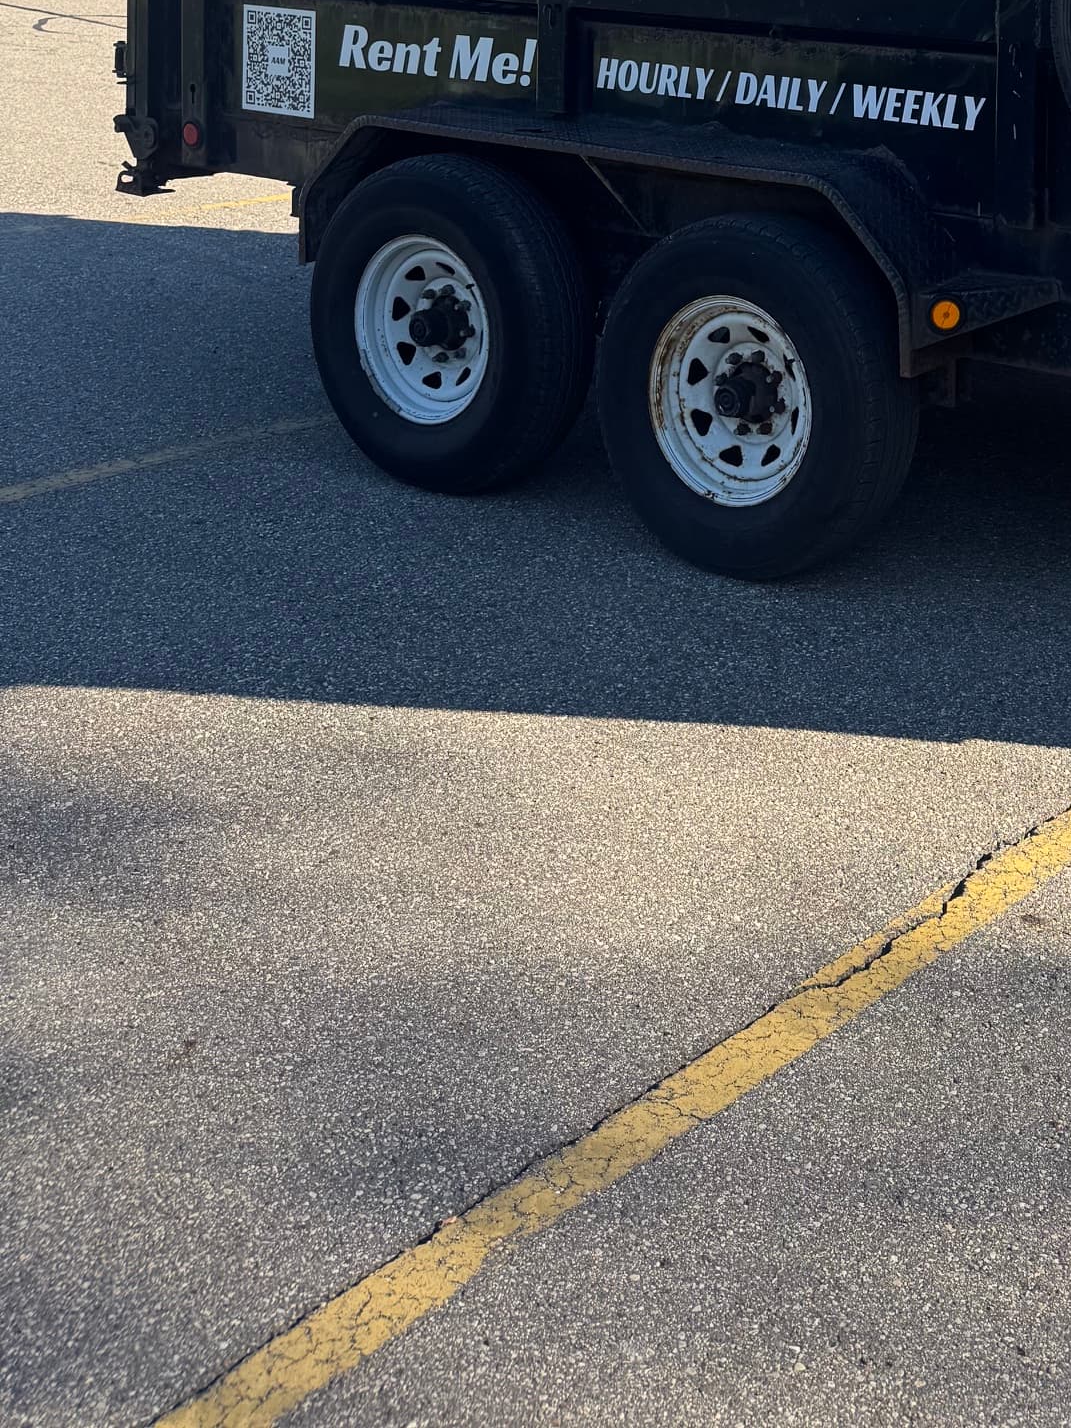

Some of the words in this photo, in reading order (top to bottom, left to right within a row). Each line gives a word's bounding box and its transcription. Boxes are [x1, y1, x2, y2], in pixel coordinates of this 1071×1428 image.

[270, 57, 286, 65] AAM
[338, 24, 442, 77] Rent
[448, 34, 538, 87] Me!
[596, 57, 715, 101] HOURLY
[734, 71, 828, 113] DAILY
[853, 83, 987, 131] WEEKLY
